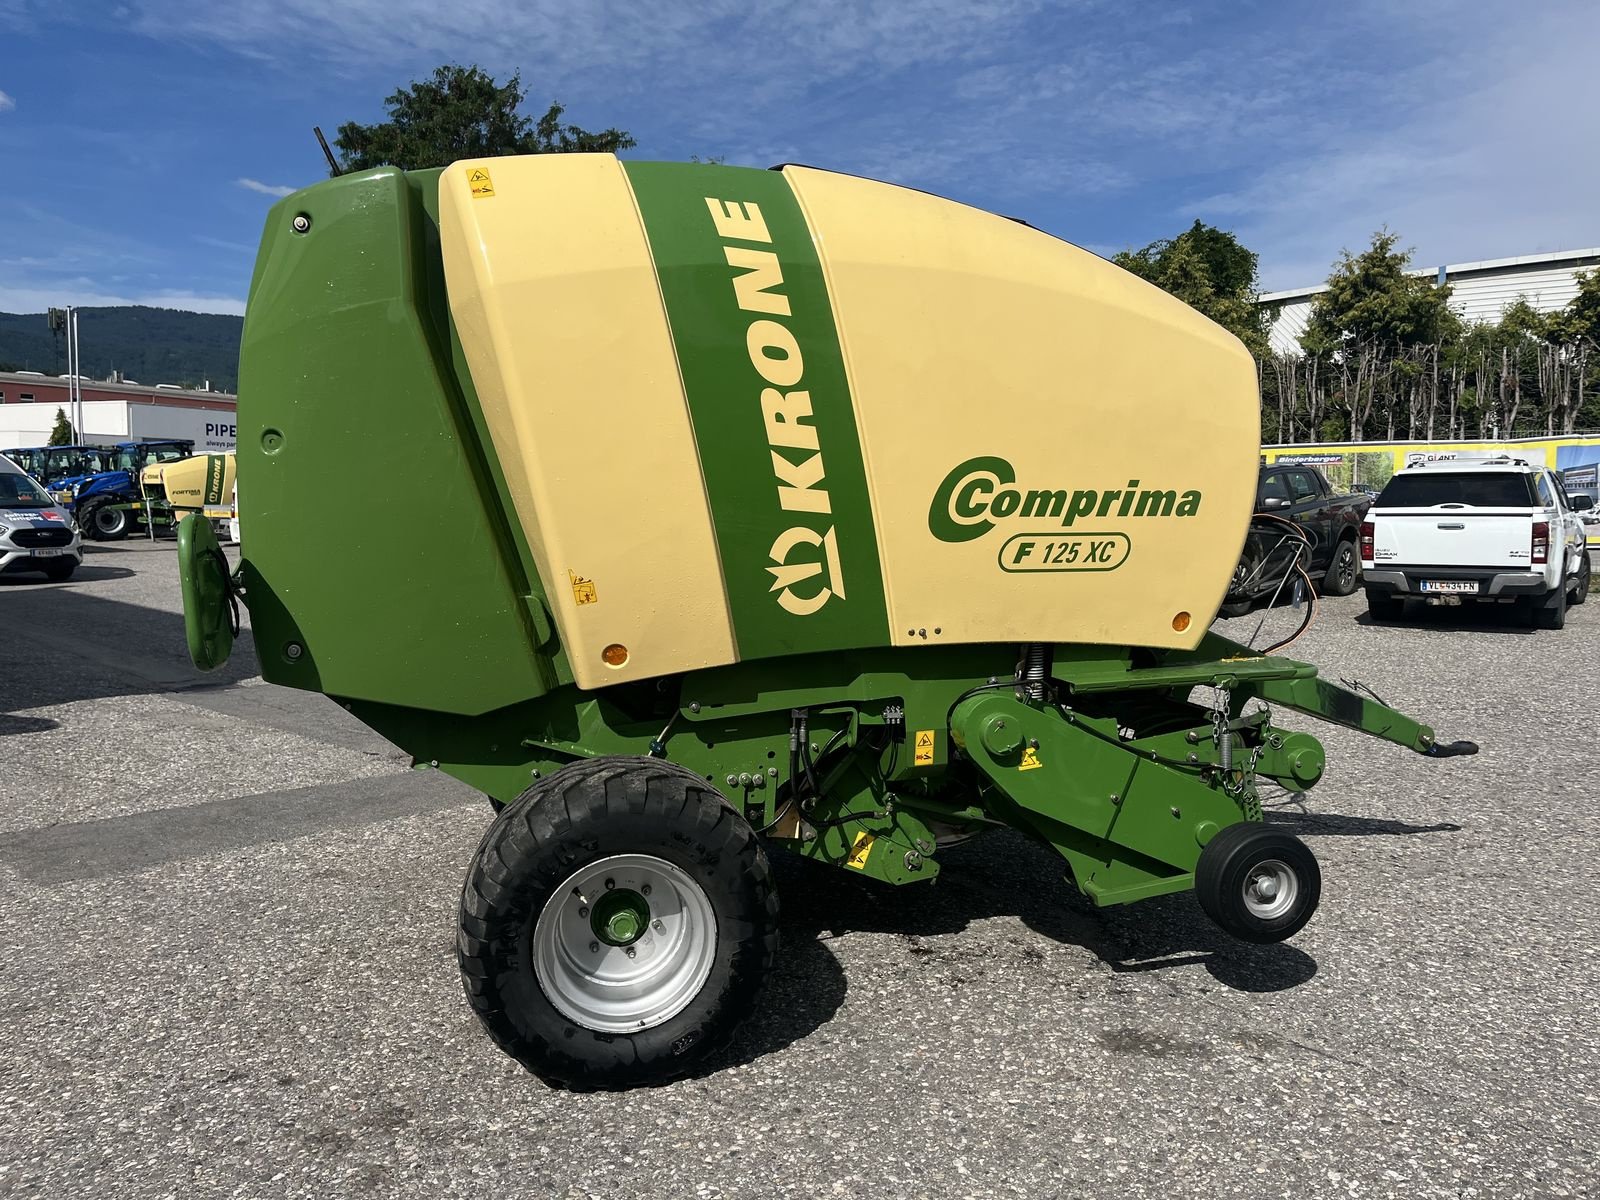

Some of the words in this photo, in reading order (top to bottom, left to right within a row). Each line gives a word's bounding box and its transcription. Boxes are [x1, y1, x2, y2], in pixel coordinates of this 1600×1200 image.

[704, 196, 832, 514] KRONE
[206, 423, 236, 437] PIPE
[206, 440, 225, 448] always
[212, 459, 222, 493] KRONE
[928, 455, 1203, 543] Comprima
[1013, 542, 1036, 564] F
[1042, 542, 1082, 564] 125
[1083, 541, 1116, 563] XC
[1429, 581, 1439, 589] VL
